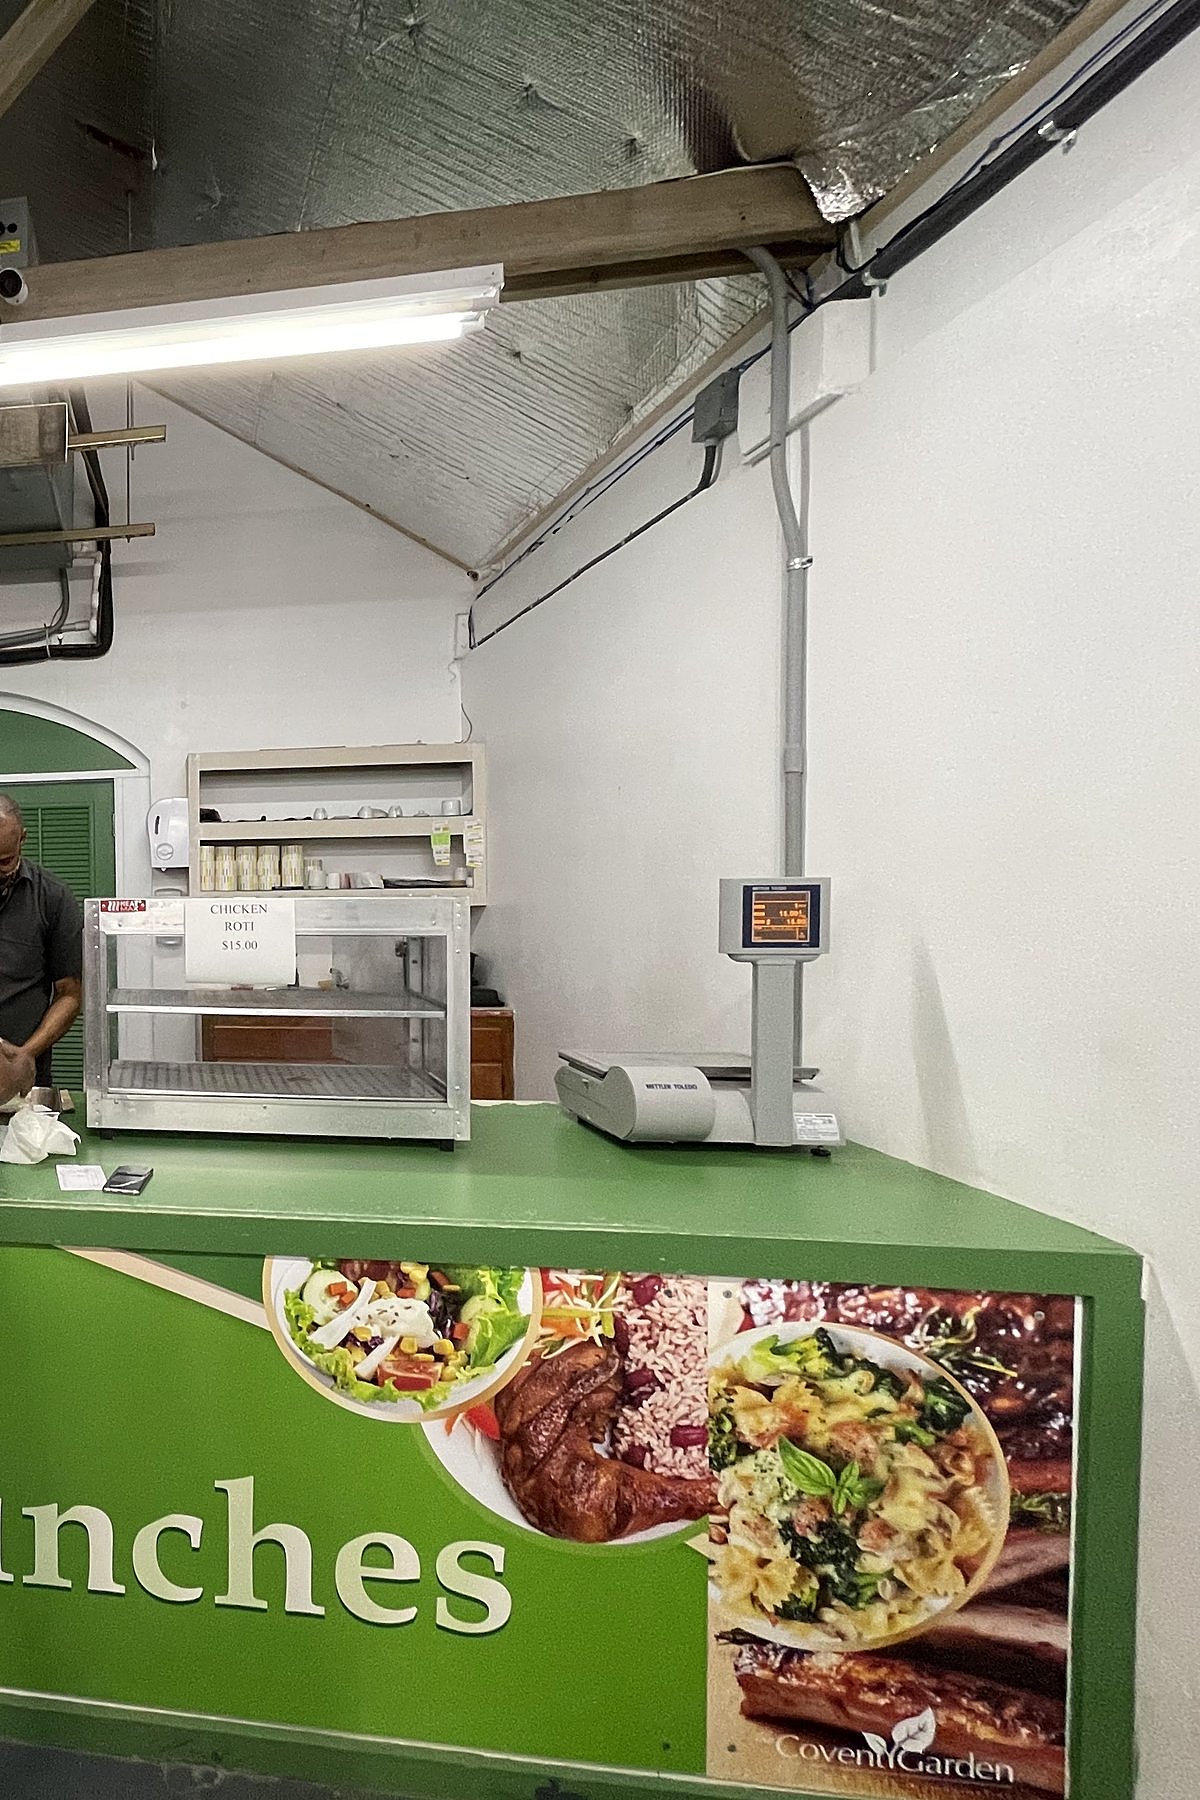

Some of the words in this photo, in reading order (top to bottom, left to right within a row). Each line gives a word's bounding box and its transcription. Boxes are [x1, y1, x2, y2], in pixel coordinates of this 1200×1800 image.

[210, 903, 268, 915] CHICKEN
[224, 921, 255, 932] ROTI
[221, 940, 258, 951] $15.00
[775, 1734, 894, 1769] Covent
[896, 1750, 1014, 1783] Garden
